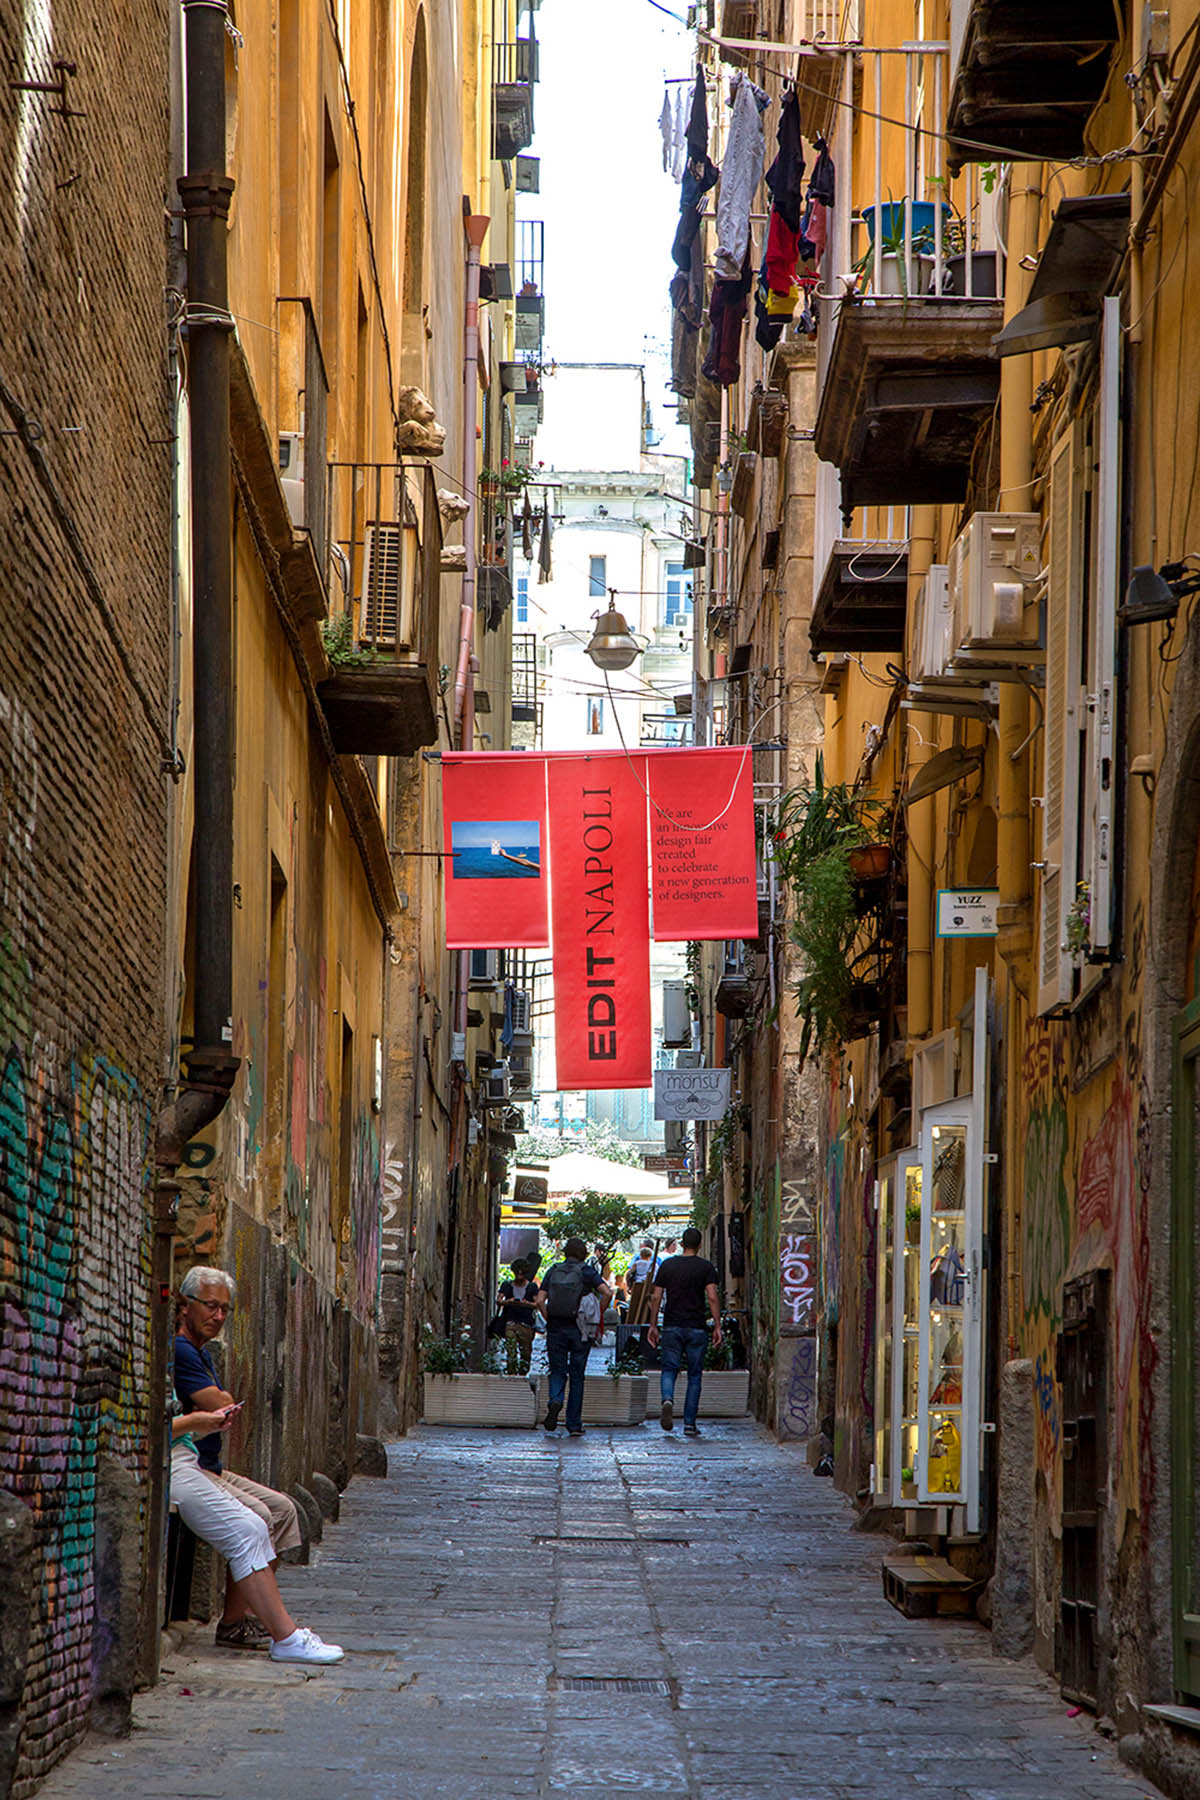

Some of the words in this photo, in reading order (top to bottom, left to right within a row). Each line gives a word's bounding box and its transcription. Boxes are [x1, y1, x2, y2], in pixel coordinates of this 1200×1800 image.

[656, 808, 674, 818] We
[676, 809, 693, 818] are
[656, 824, 670, 832] an
[656, 835, 692, 848] design
[694, 834, 713, 845] fair
[657, 848, 696, 859] created
[583, 786, 615, 936] NAPOLI
[658, 864, 669, 873] to
[671, 862, 719, 873] celebrate
[658, 879, 665, 887] a
[667, 878, 690, 887] new
[692, 875, 750, 889] generation
[658, 891, 670, 900] of
[672, 890, 726, 902] designers.
[957, 895, 983, 904] YUZZ
[586, 947, 617, 1060] EDIT
